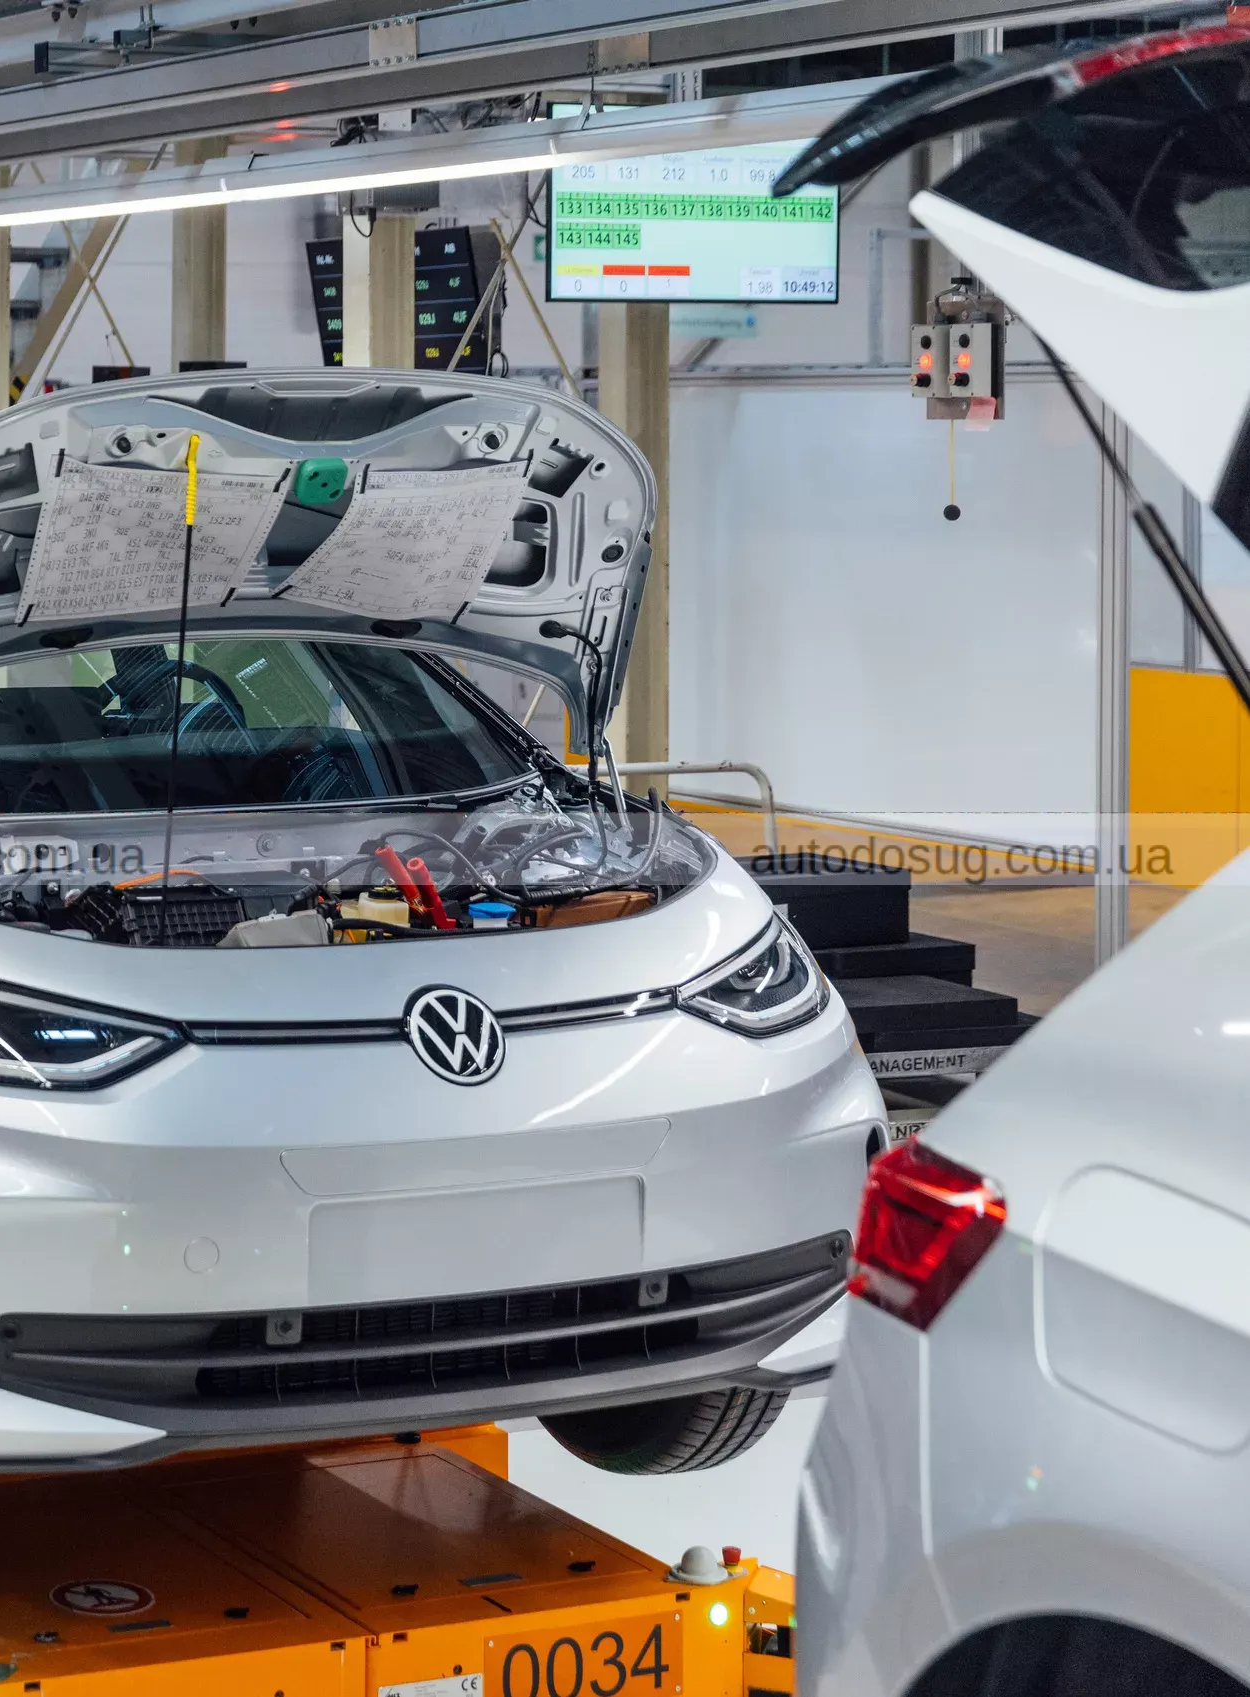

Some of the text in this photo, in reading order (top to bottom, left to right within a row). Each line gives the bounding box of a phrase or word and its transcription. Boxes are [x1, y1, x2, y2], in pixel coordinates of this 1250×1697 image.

[572, 165, 595, 179] 205
[618, 167, 639, 179] 131
[662, 167, 685, 180] 212
[559, 201, 832, 219] 133 134 135 136 137 138 139 140 141 142
[559, 232, 639, 246] 143 144 145
[783, 281, 834, 294] 10:49:12
[870, 1054, 966, 1073] ANAGEMENT
[502, 1624, 669, 1697] 0034
